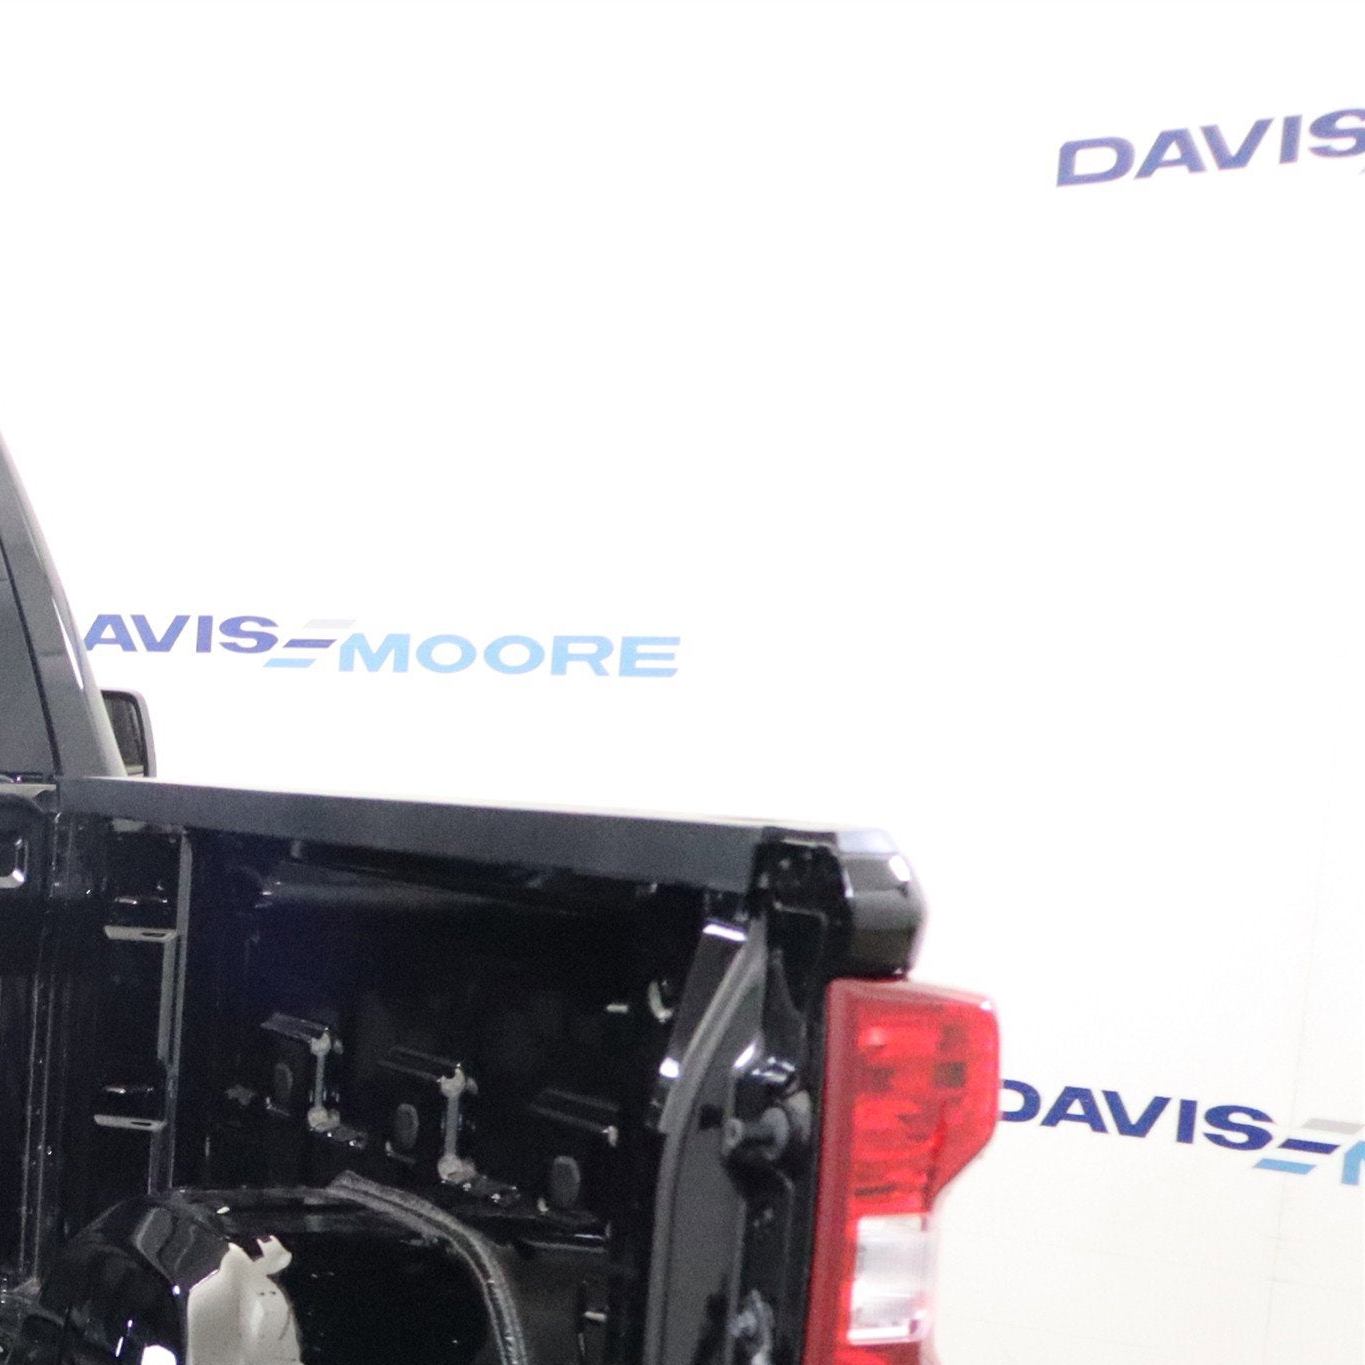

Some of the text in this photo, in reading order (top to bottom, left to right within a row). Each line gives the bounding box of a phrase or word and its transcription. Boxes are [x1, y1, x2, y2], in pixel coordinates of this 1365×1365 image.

[1056, 108, 1365, 187] DAVIS
[84, 614, 681, 678] AVIS MOORE
